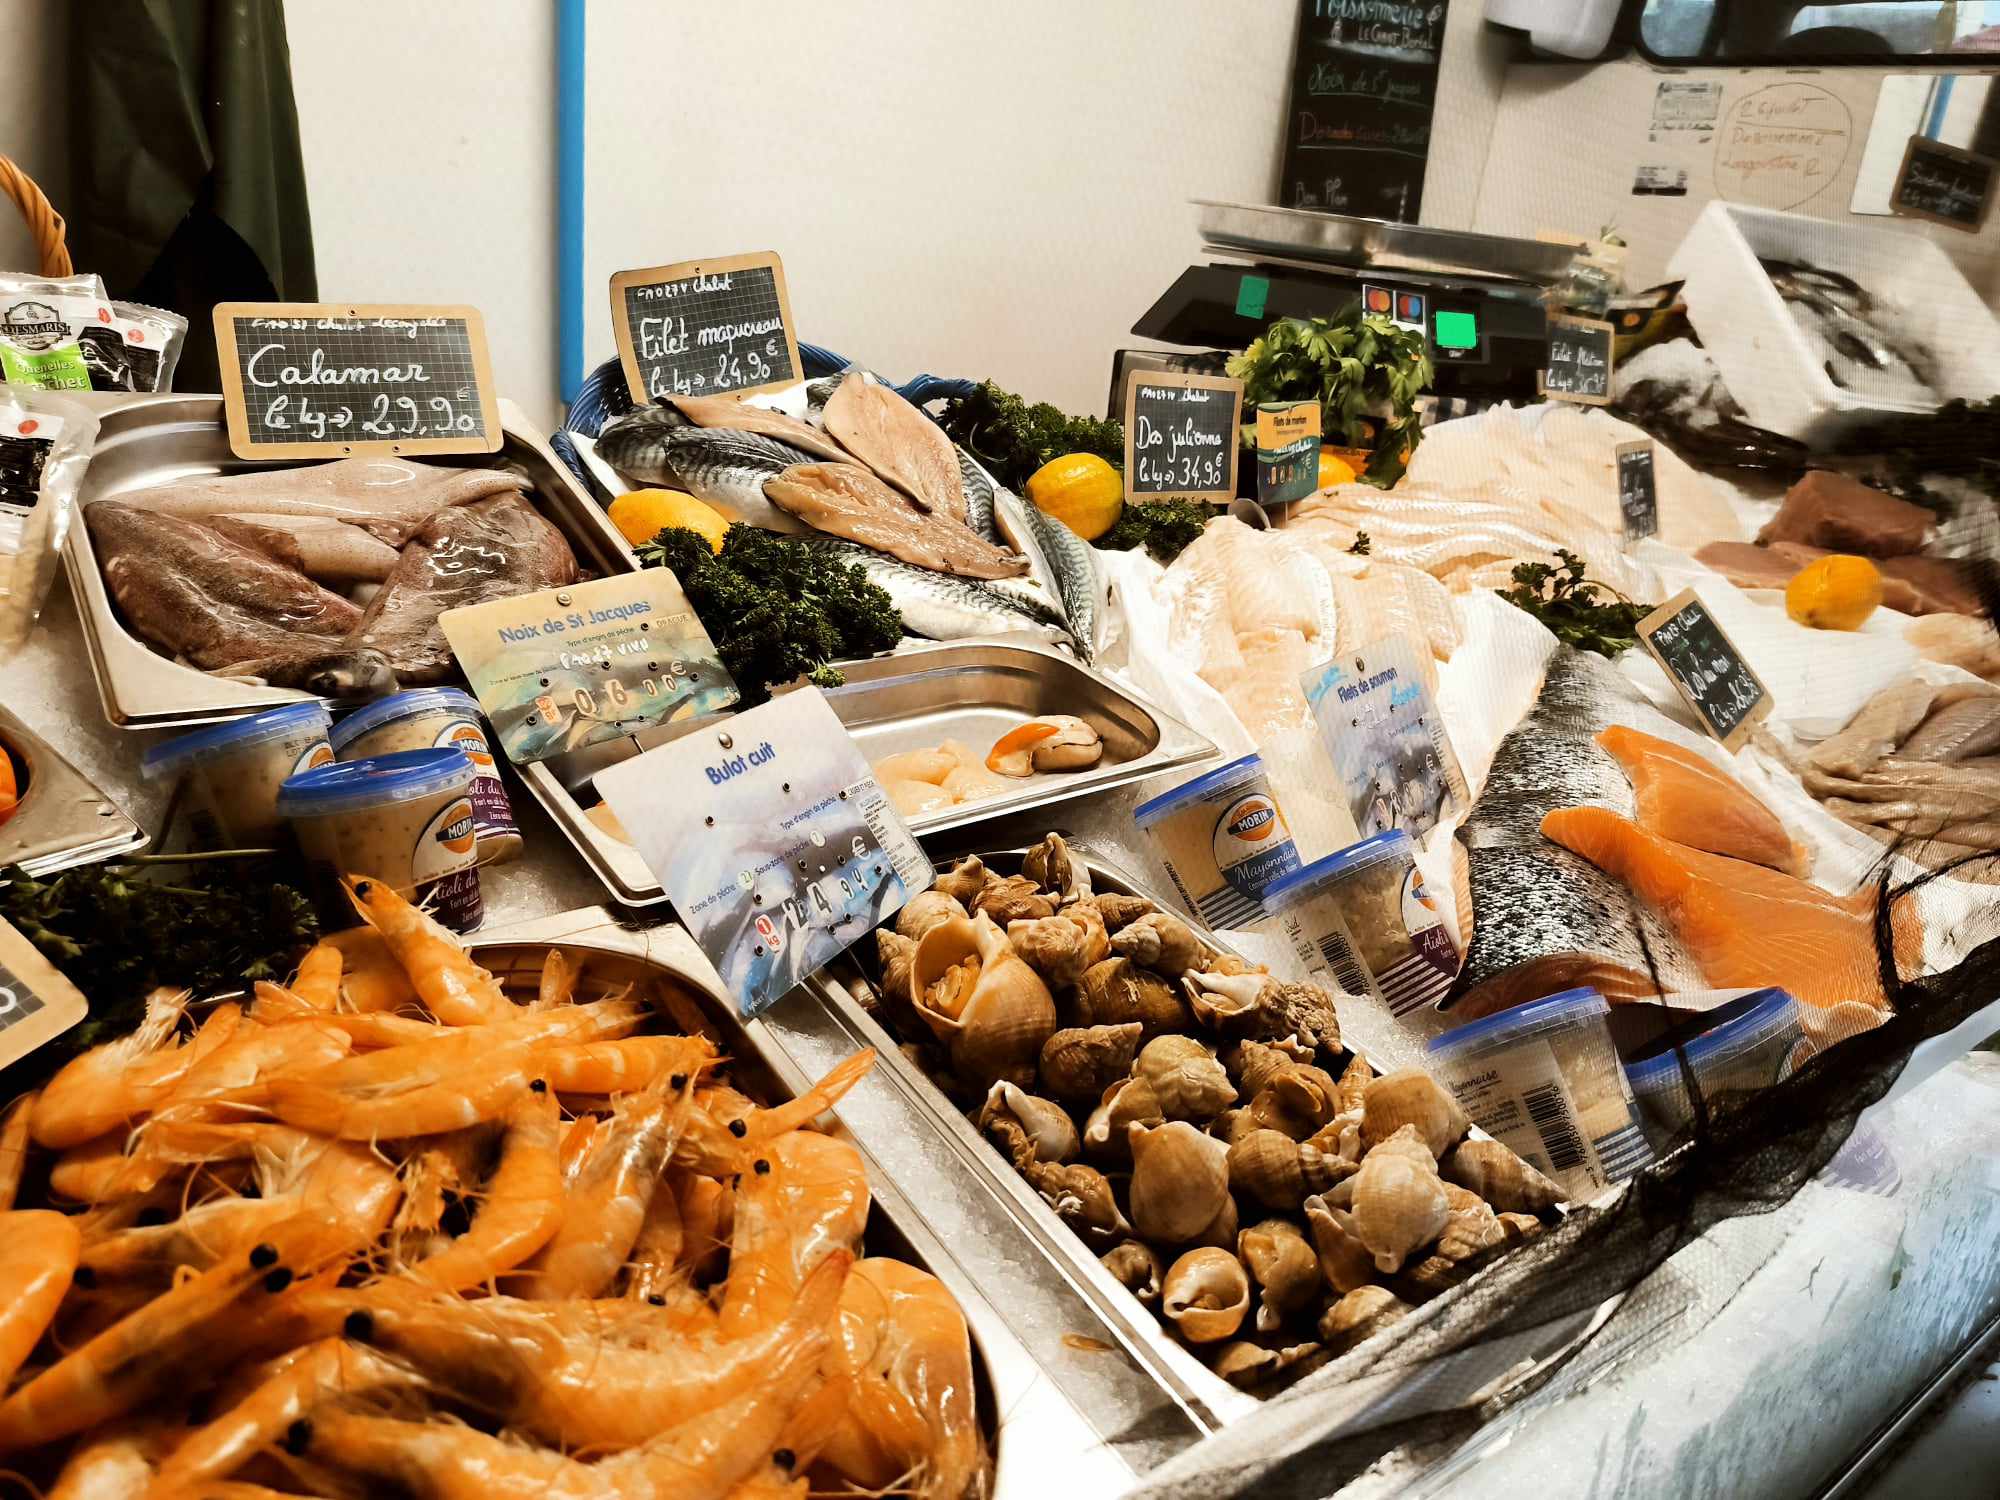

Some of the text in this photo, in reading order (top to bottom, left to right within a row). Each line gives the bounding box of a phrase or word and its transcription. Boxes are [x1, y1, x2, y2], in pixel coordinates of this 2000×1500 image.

[640, 317, 689, 360] Filet
[247, 343, 431, 388] Calamar
[650, 366, 670, 397] le
[264, 394, 291, 429] le
[299, 397, 326, 438] kg
[1136, 416, 1222, 463] Dos julienne
[498, 601, 652, 643] Noix de St Jacques
[670, 660, 686, 676] €
[1337, 682, 1358, 703] Filets
[1359, 678, 1369, 694] de
[705, 741, 776, 785] Bulot cuit
[1236, 809, 1270, 831] MORIN
[851, 835, 872, 861] €
[1235, 847, 1297, 885] Mayonnaise
[689, 902, 708, 914] Zone
